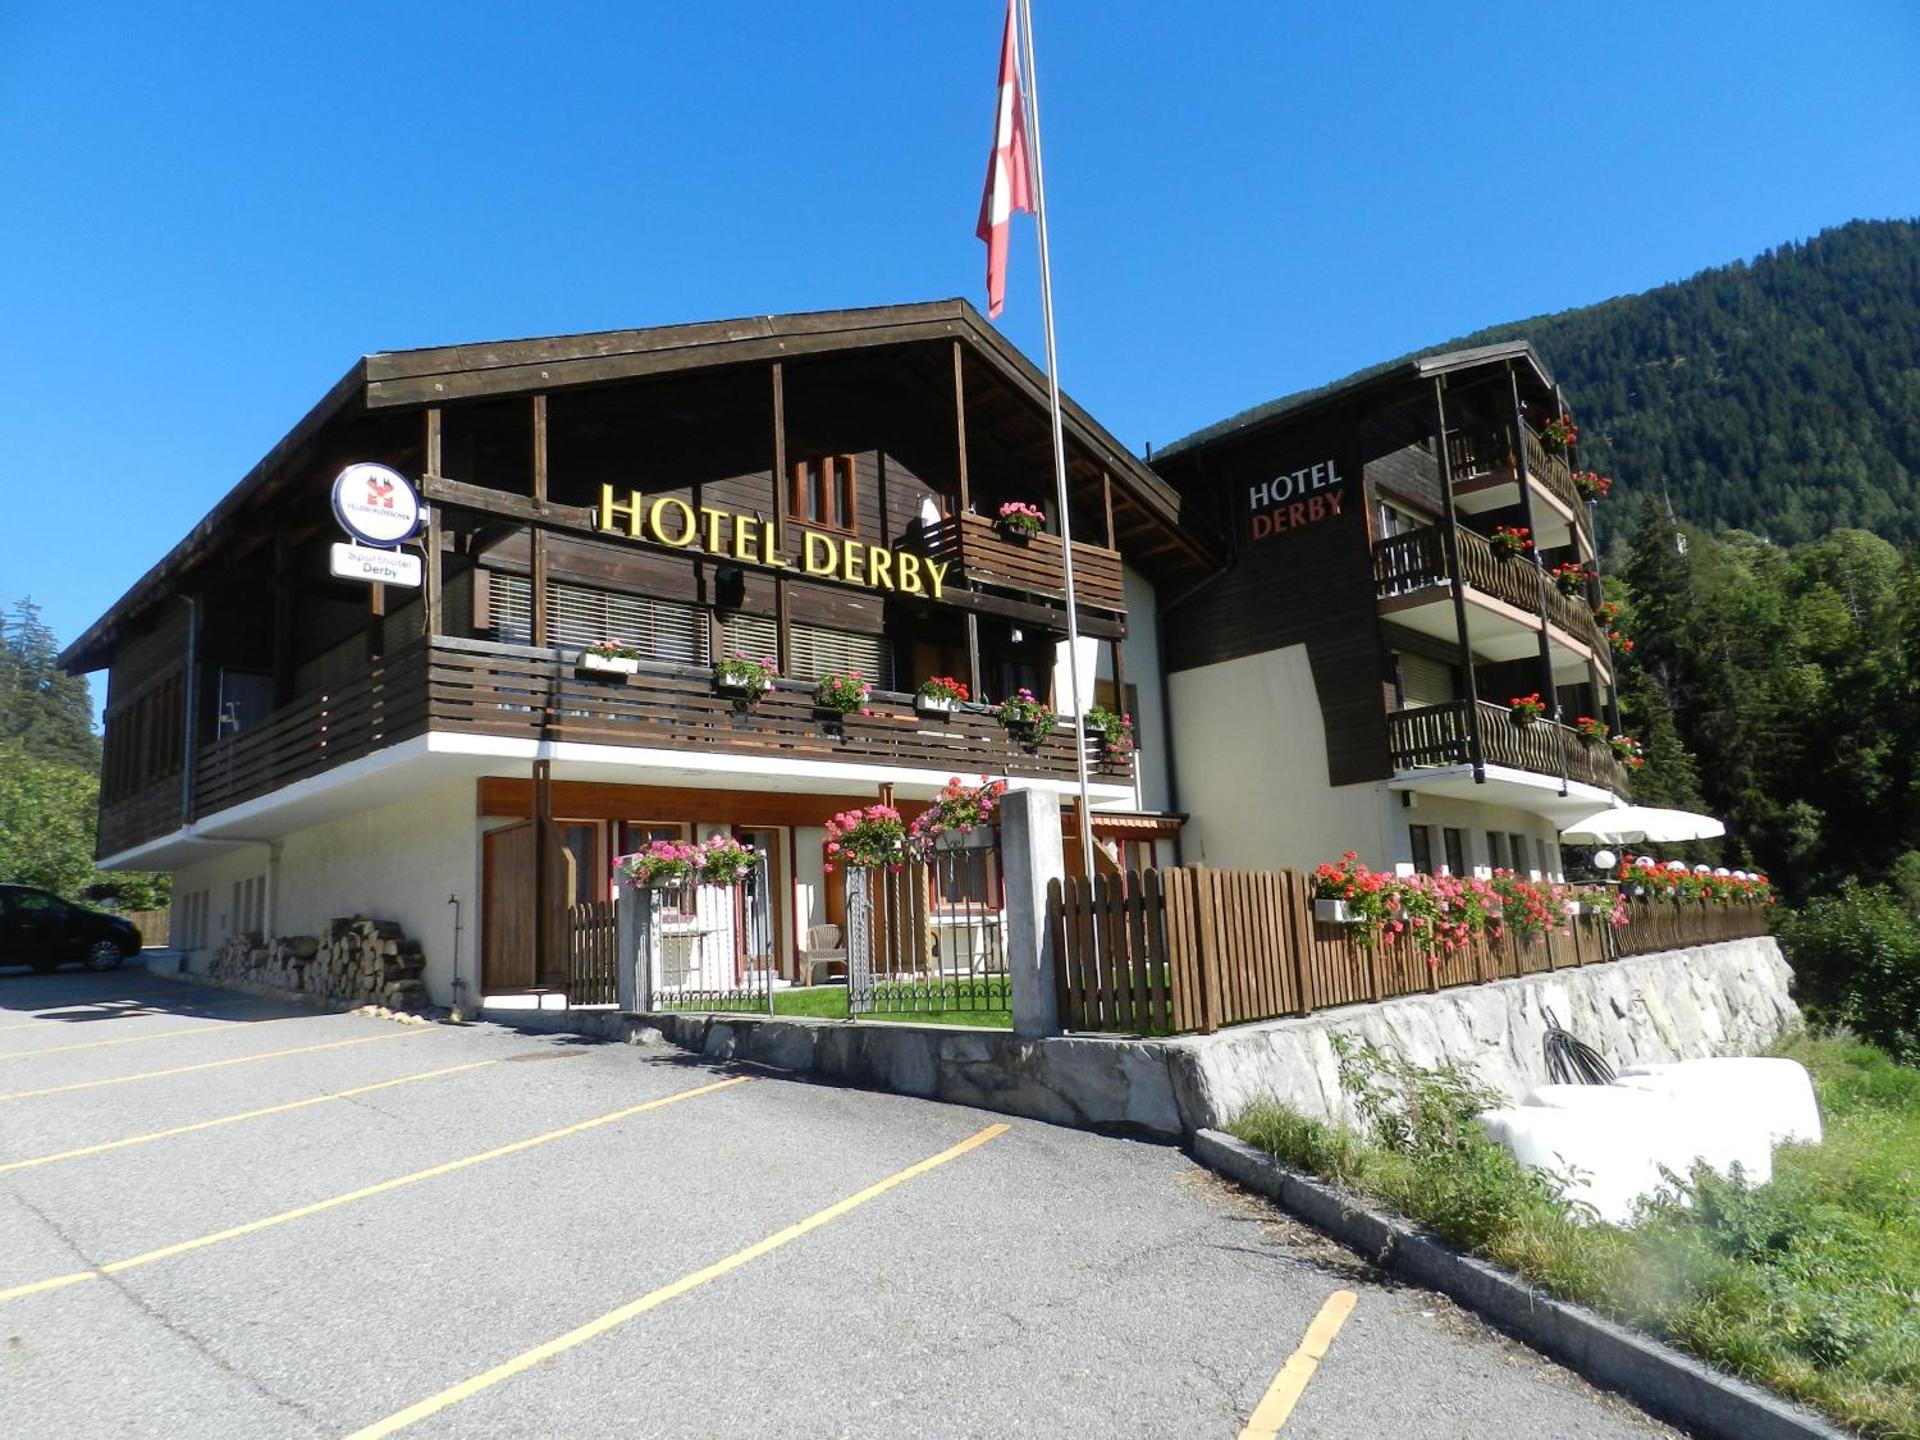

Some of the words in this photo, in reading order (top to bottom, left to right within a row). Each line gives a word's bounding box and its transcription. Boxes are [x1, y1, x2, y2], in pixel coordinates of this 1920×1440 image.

[1249, 459, 1342, 510] HOTEL
[601, 482, 788, 568] HOTEL
[803, 530, 949, 599] DERBY
[1250, 488, 1343, 541] DERBY
[362, 562, 398, 579] Derby
